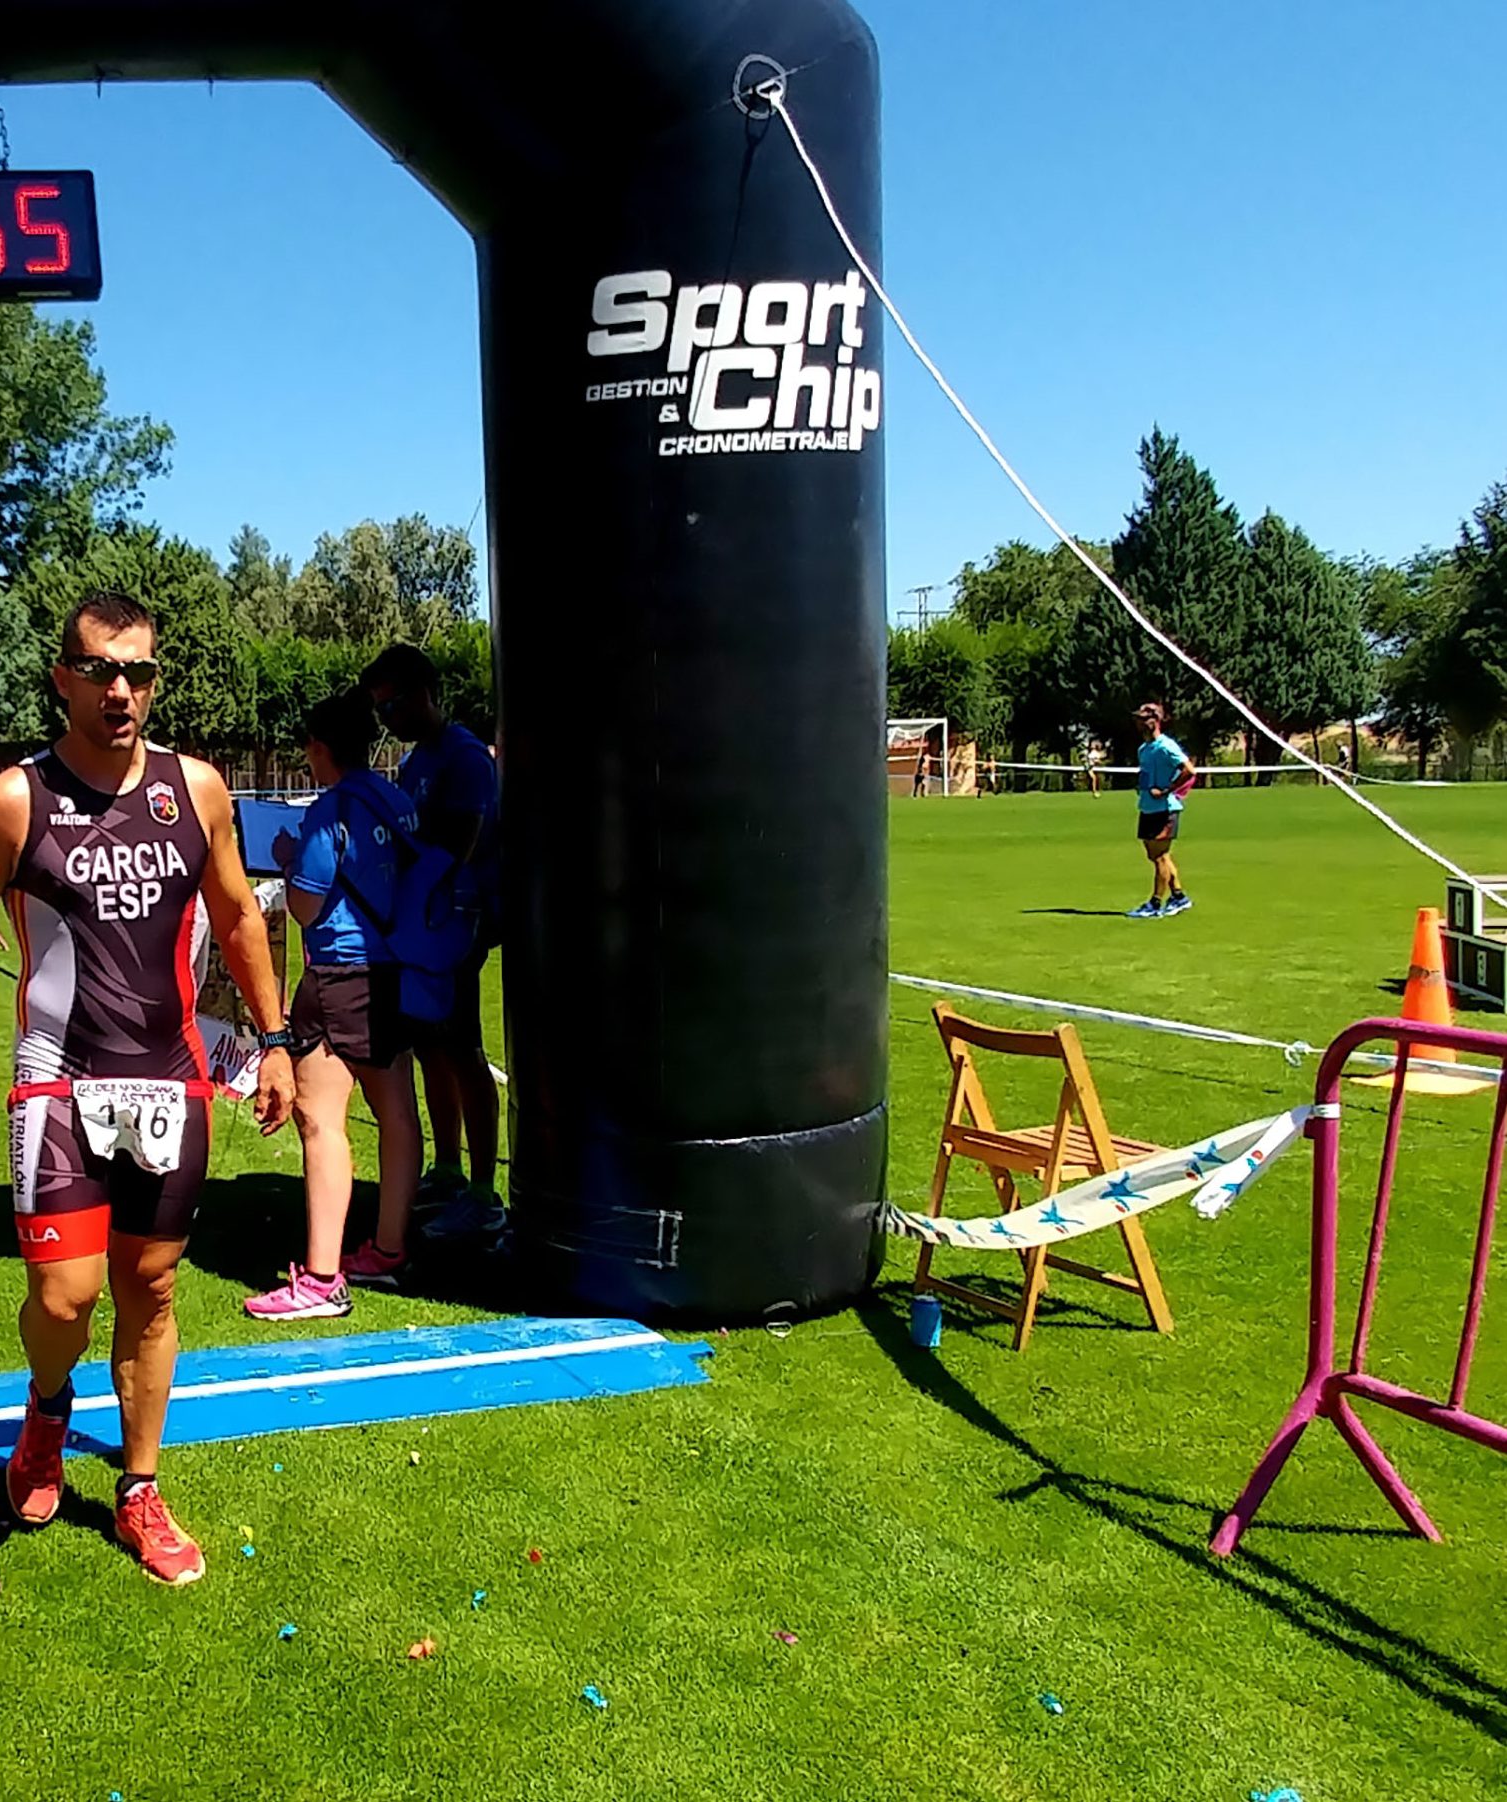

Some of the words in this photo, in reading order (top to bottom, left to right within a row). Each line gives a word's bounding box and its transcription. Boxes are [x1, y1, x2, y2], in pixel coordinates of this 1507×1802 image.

[586, 269, 866, 372] Sport
[585, 375, 688, 402] GESTION
[688, 342, 882, 451] Chip
[658, 404, 680, 423] &
[658, 430, 849, 457] CRONOMETRAJE
[65, 840, 188, 883] GARCIA
[95, 881, 162, 921] ESP
[14, 1117, 27, 1195] TRIATLÓN
